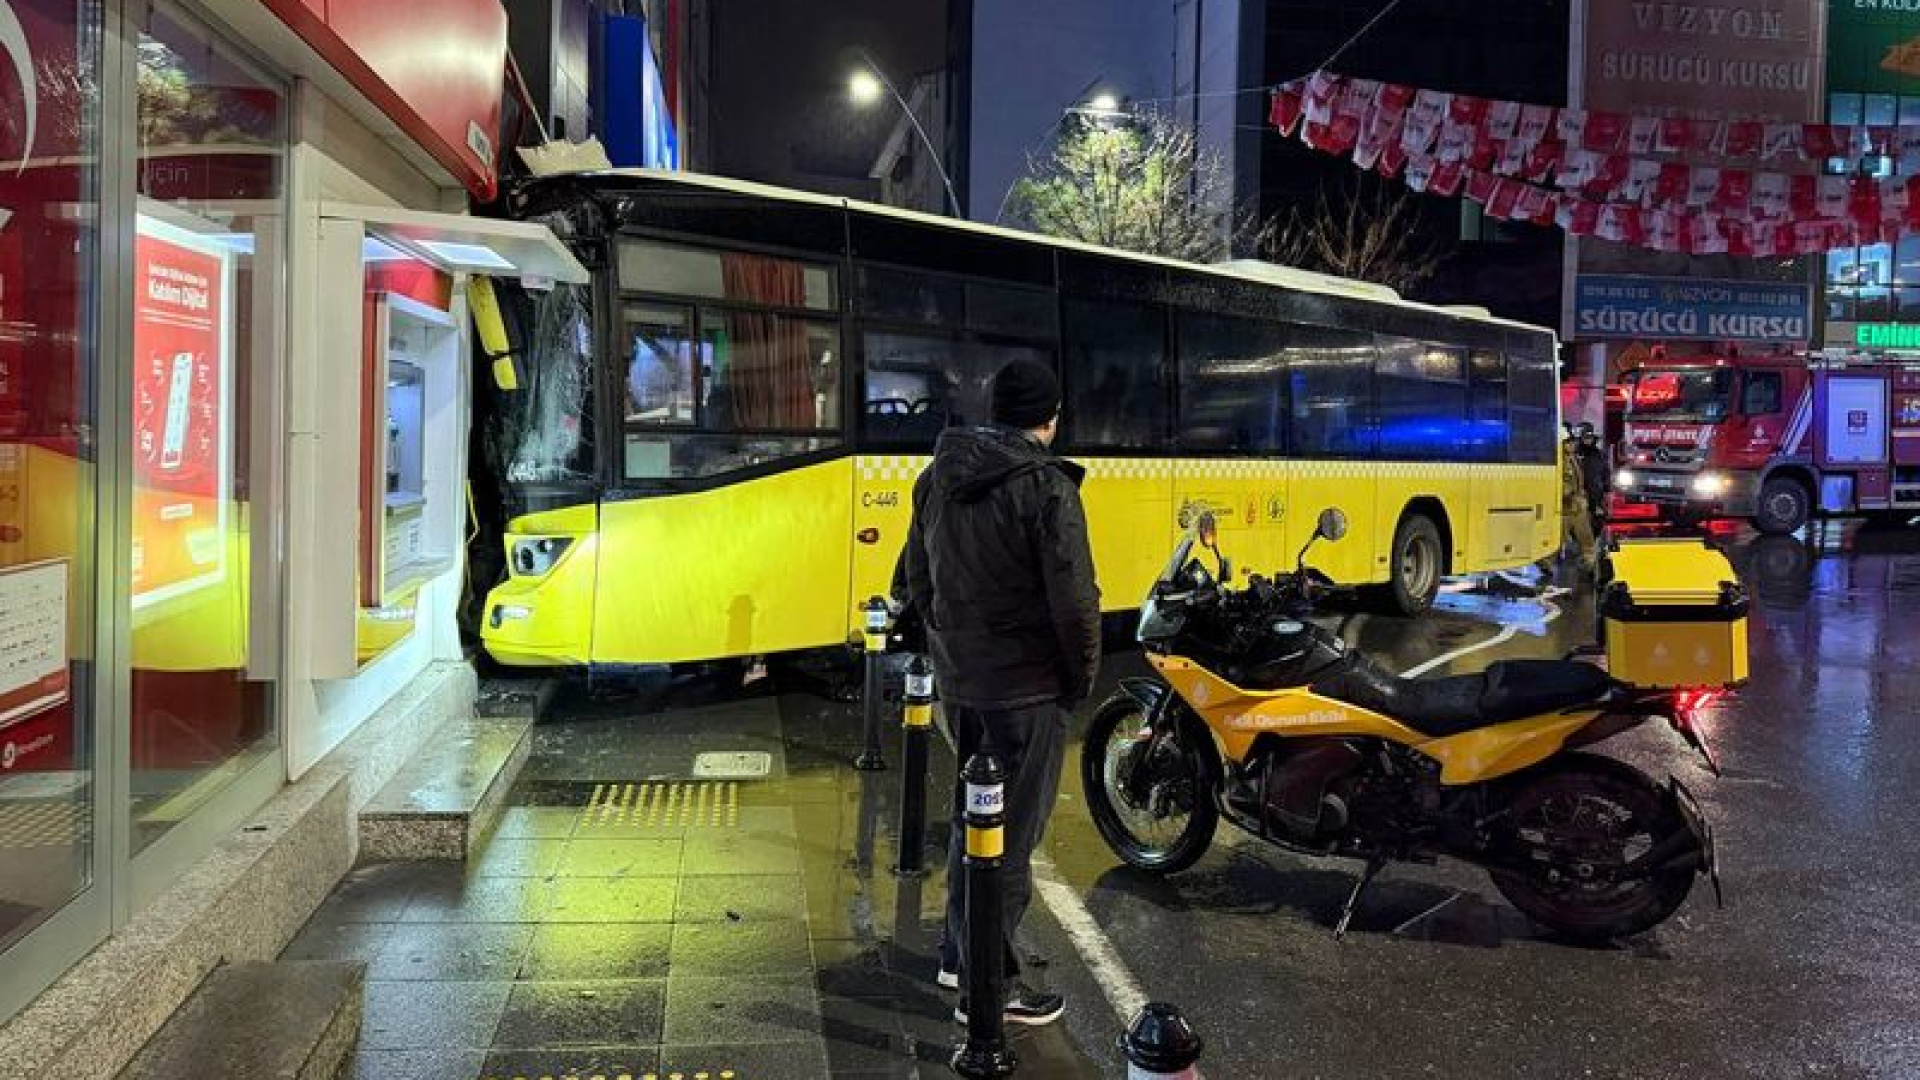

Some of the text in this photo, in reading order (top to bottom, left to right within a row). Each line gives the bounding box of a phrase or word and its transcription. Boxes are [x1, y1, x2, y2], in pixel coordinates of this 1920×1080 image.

[1719, 58, 1809, 91] KURSU
[1580, 304, 1803, 339] SÜRÜCÜ KURSU
